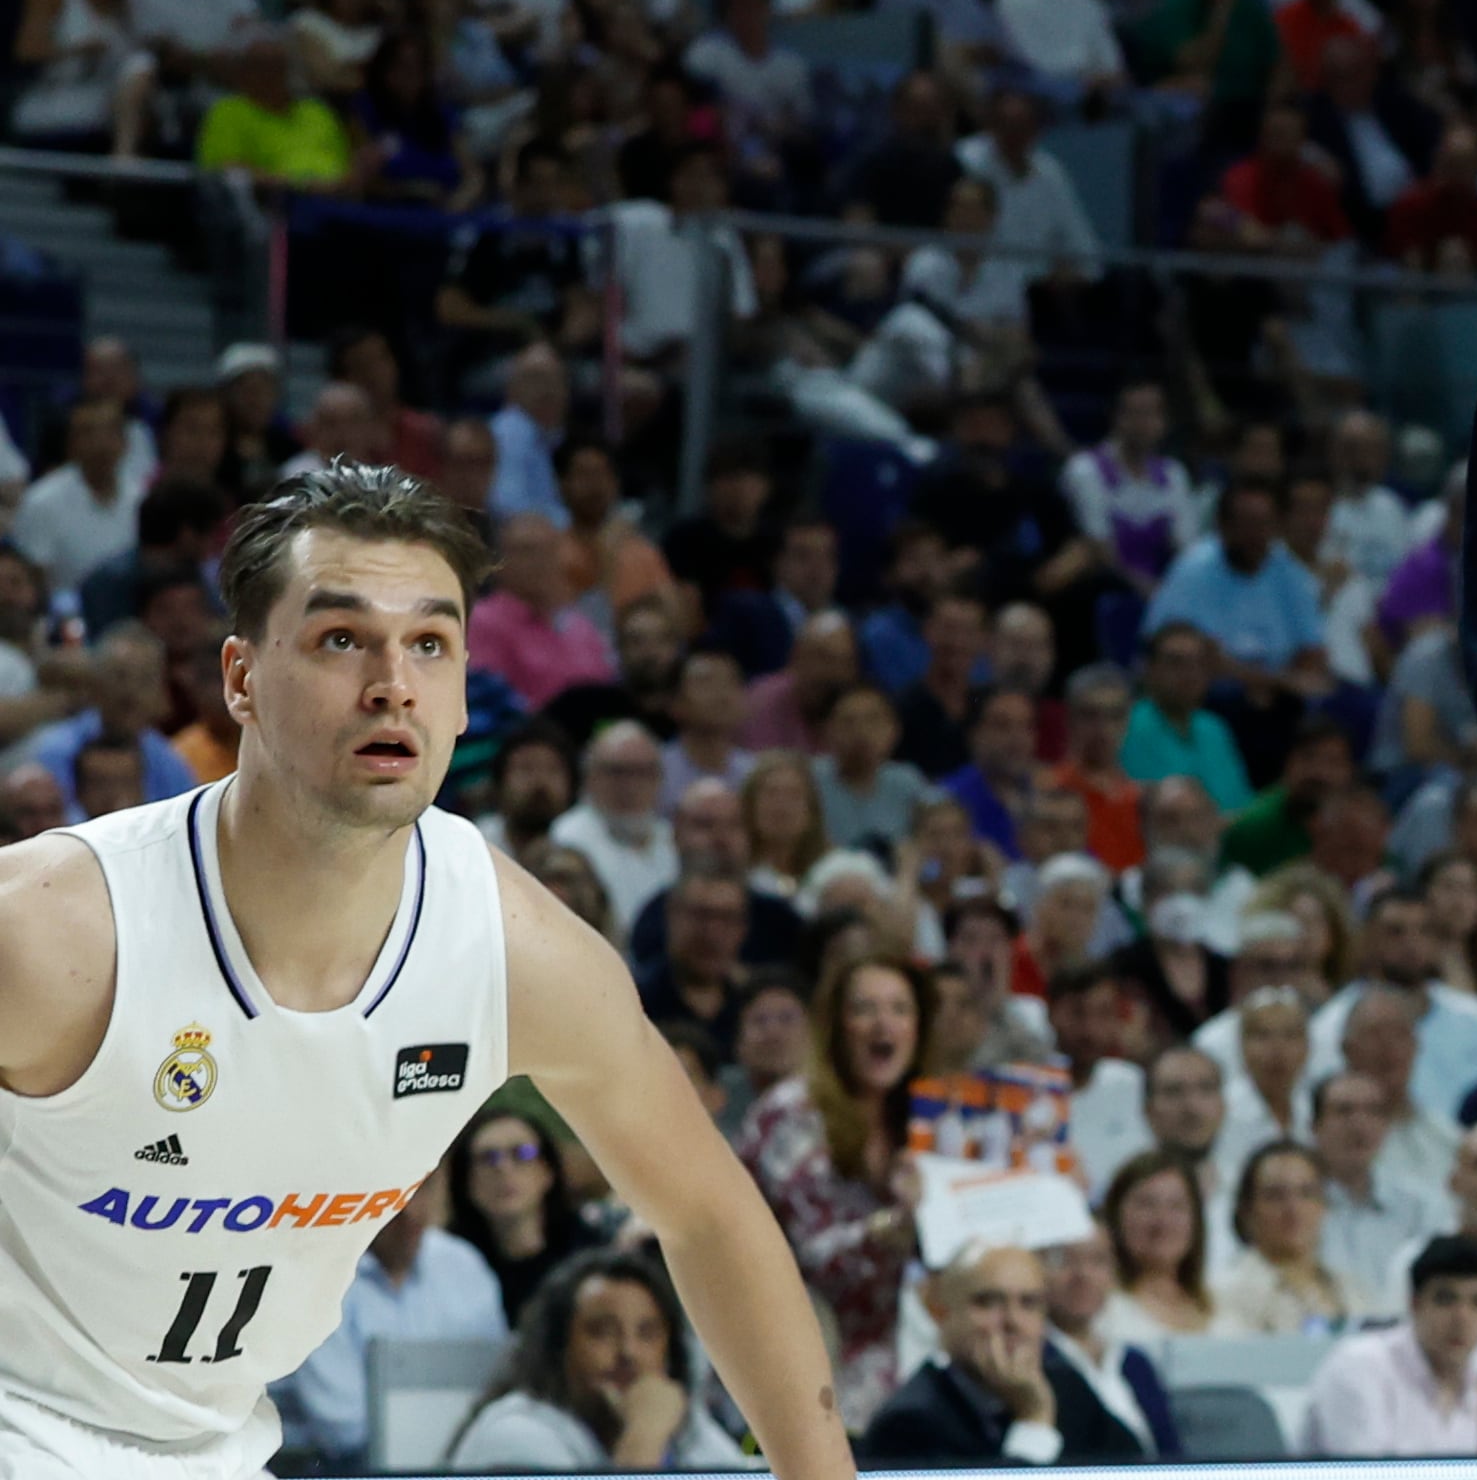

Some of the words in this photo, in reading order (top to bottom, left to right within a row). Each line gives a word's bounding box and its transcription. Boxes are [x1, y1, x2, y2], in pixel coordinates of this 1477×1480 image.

[399, 1060, 428, 1079] liga
[397, 1073, 461, 1093] endesa
[134, 1150, 189, 1166] adidas
[146, 1265, 273, 1364] 11
